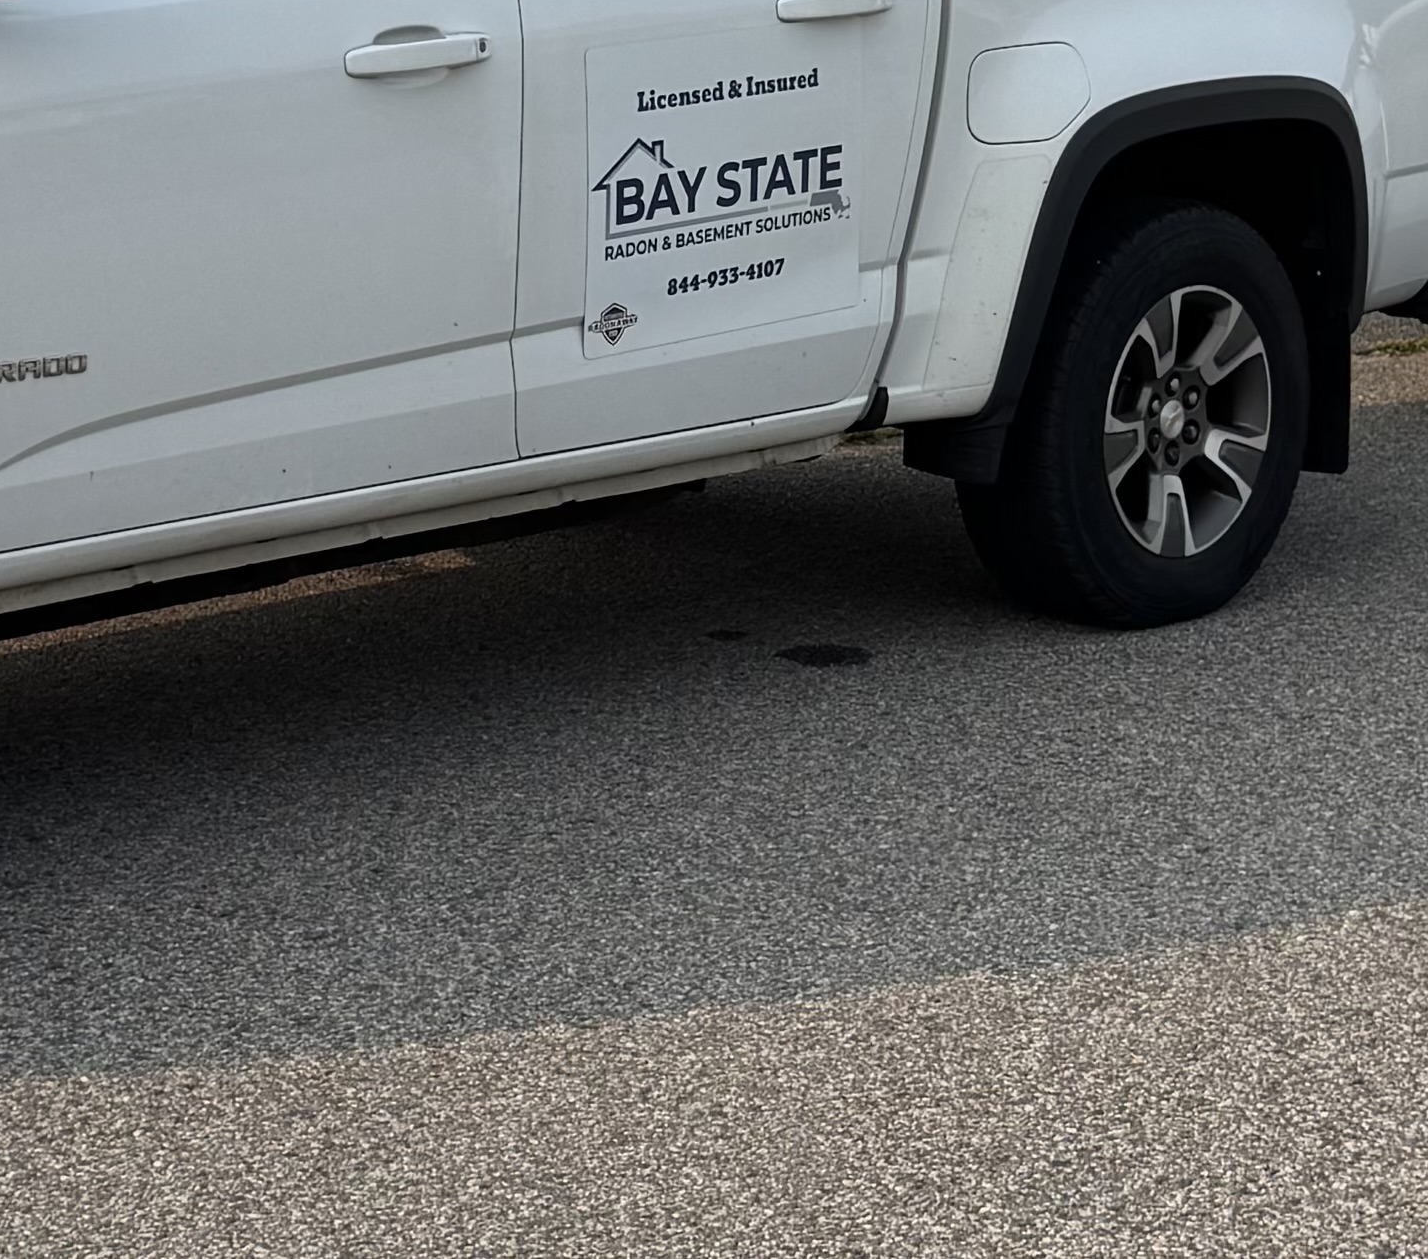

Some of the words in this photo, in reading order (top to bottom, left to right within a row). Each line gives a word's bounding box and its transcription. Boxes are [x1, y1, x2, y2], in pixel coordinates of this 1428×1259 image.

[636, 80, 725, 112] Licensed
[728, 79, 742, 99] &
[746, 67, 819, 96] Insured
[615, 166, 708, 226] BAY
[716, 144, 843, 208] STATE
[604, 237, 658, 261] RADON
[661, 235, 672, 250] &
[676, 220, 753, 248] BASEMENT
[755, 206, 832, 234] SOLUTIONS
[666, 257, 786, 296] 844-933-4107
